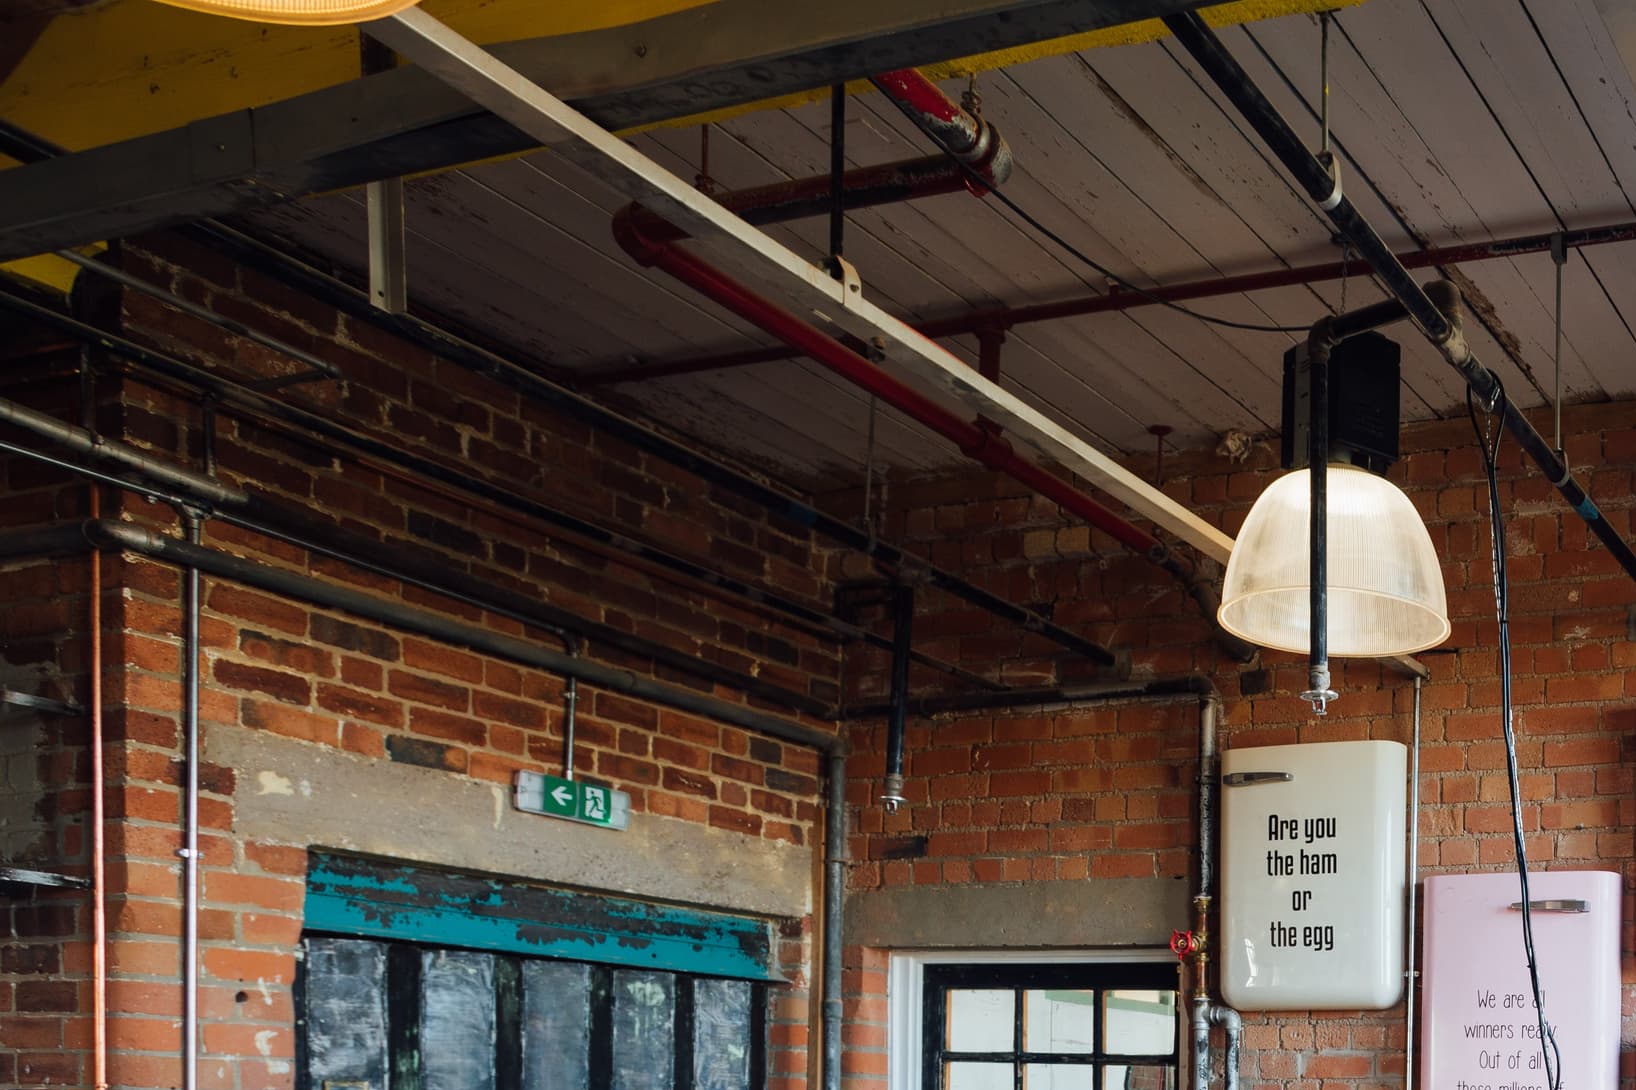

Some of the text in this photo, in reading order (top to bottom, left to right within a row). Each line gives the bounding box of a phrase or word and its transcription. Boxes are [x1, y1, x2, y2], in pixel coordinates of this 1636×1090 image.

[1268, 814, 1336, 844] Are you
[1266, 849, 1337, 876] the ham
[1292, 890, 1312, 911] or
[1270, 921, 1334, 952] the egg
[1477, 989, 1546, 1008] We are al
[1464, 1021, 1557, 1044] winners reay
[1479, 1050, 1542, 1069] Out of all
